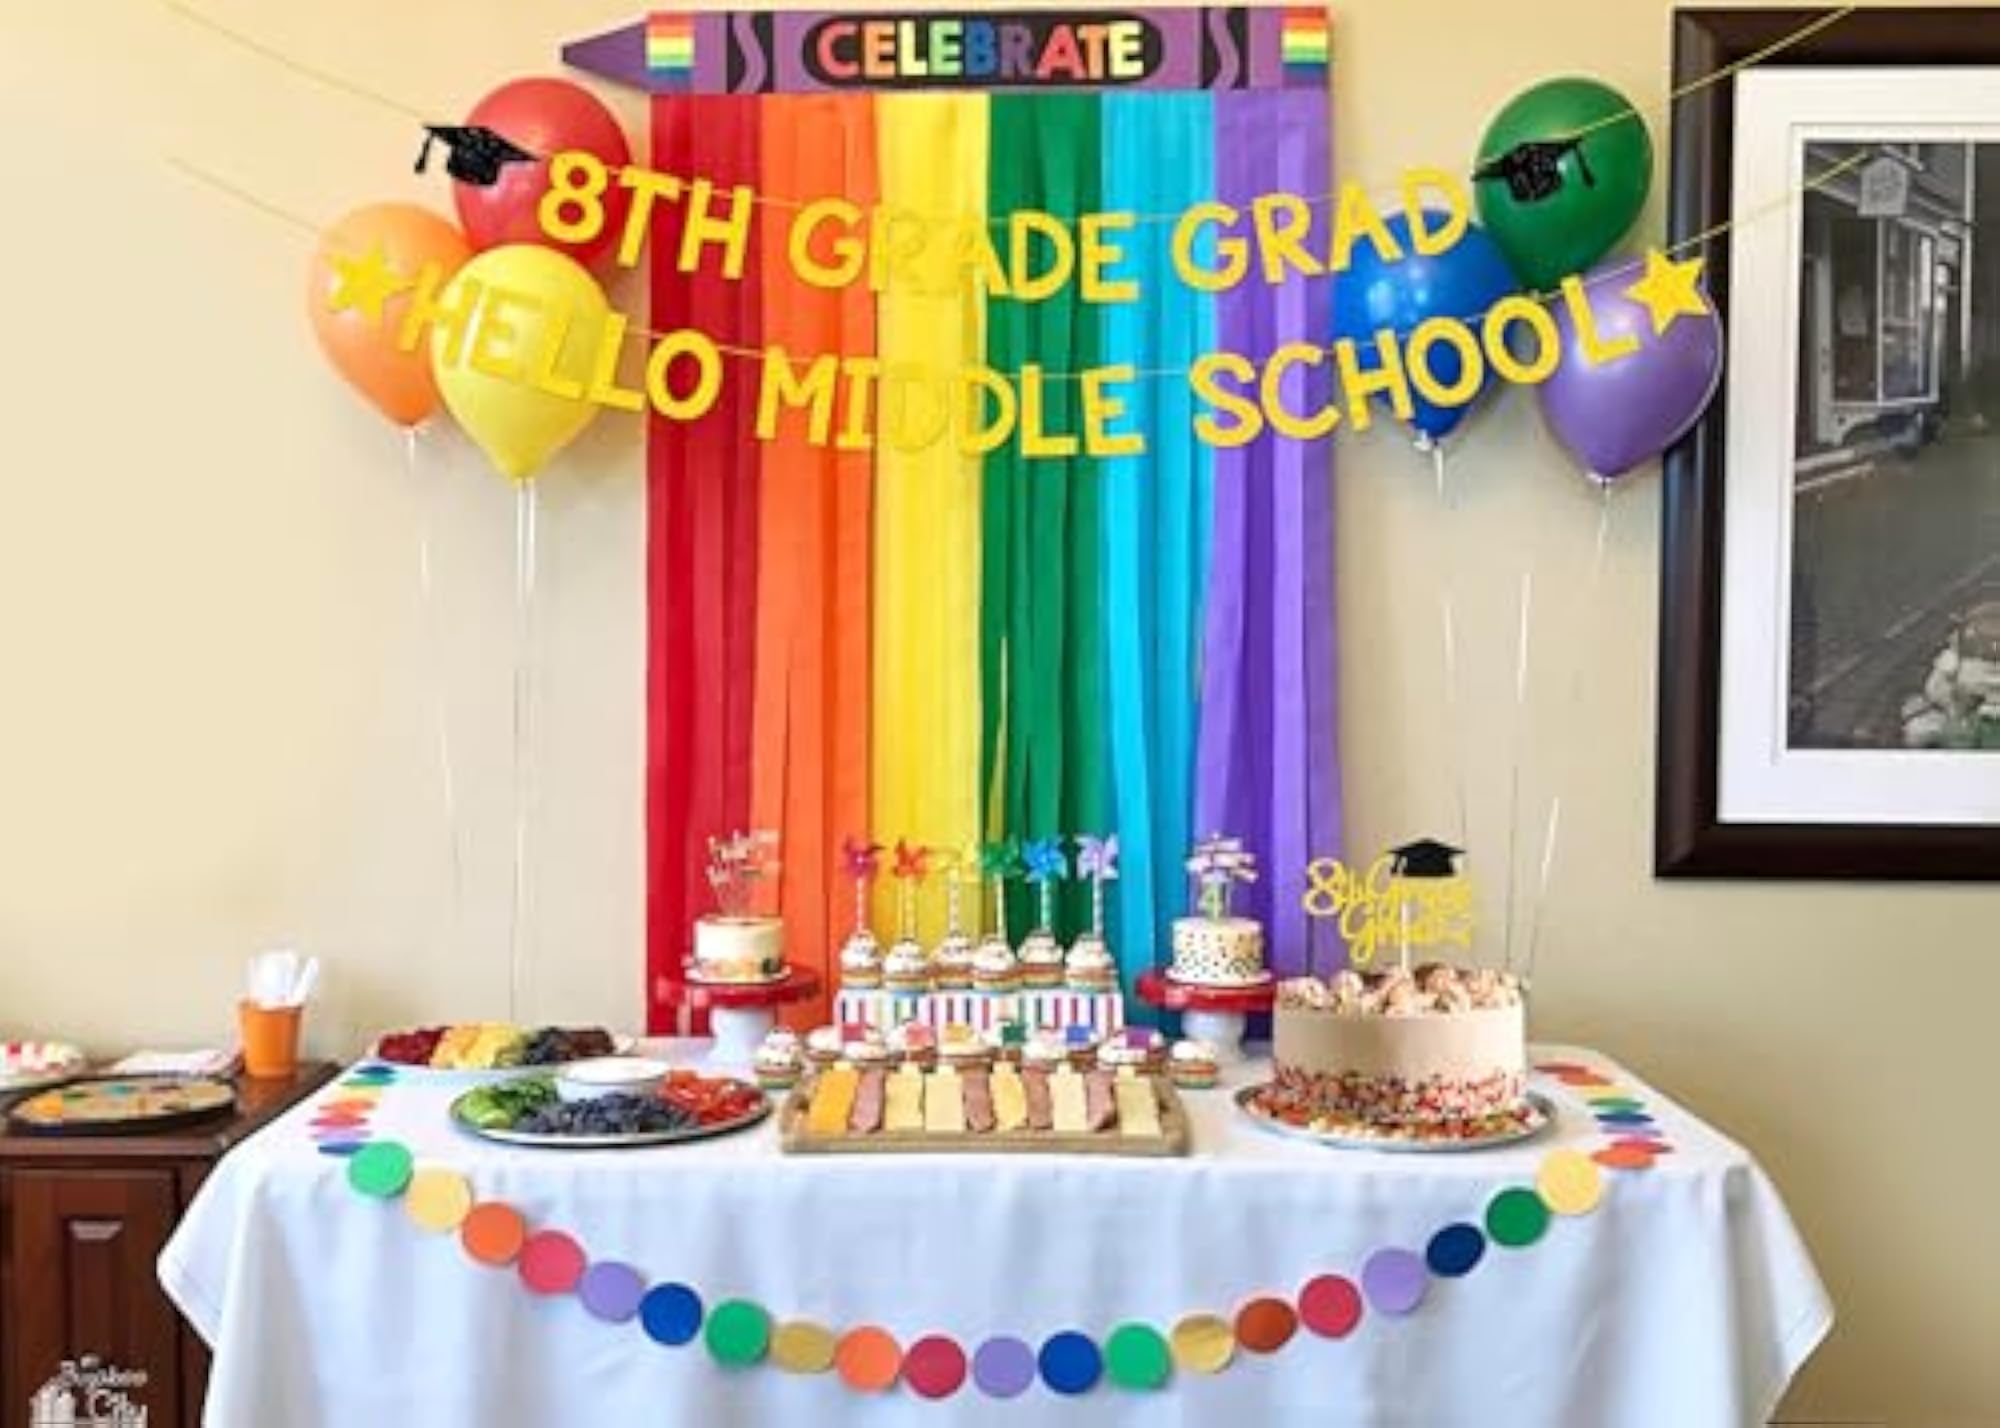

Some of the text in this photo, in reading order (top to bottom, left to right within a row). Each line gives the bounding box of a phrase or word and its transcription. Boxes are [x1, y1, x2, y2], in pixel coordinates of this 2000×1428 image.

[816, 20, 1144, 79] CELEBRATE
[537, 150, 1471, 304] 8TH GRADE GRAD
[400, 263, 1640, 458] HELLO MIDDLE SCHOOL
